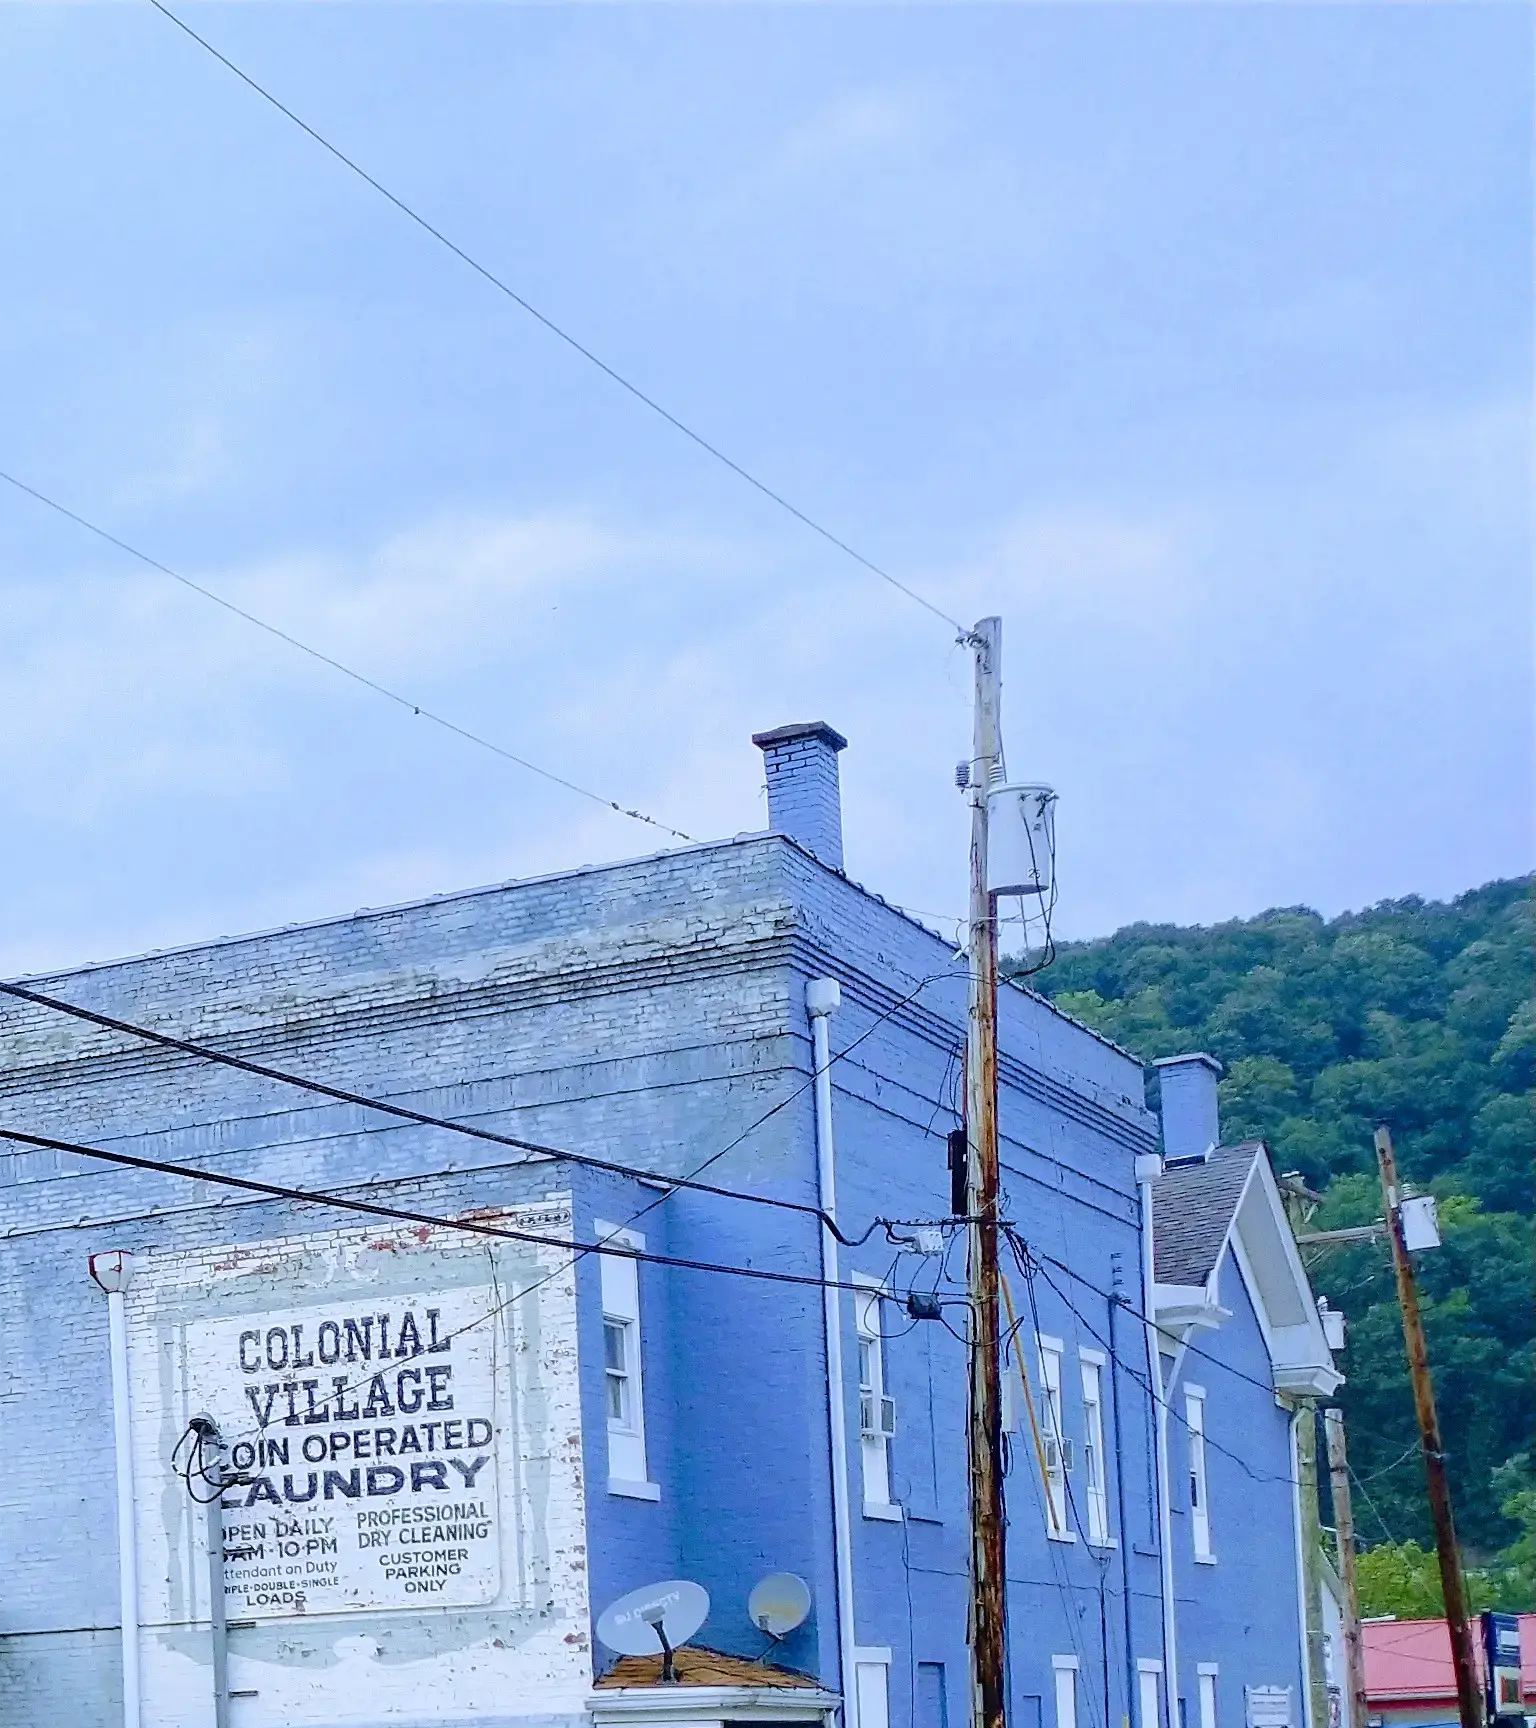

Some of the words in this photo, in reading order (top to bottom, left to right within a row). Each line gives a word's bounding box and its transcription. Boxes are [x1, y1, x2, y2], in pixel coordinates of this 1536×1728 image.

[238, 1308, 452, 1374] COLONIAL
[244, 1365, 455, 1428] VILLAGE
[302, 1418, 493, 1462] OPERATED
[357, 1501, 489, 1529] PROFESSIONAL
[275, 1517, 334, 1538] DAILY
[358, 1529, 392, 1549] DRY
[399, 1522, 489, 1545] CLEANING
[379, 1548, 469, 1566] CUSTOMER
[224, 1564, 282, 1580] ttendant
[285, 1565, 302, 1575] on
[305, 1561, 338, 1574] Duty
[385, 1563, 462, 1580] PARKING
[404, 1579, 448, 1594] ONLY
[246, 1590, 307, 1606] LOADS
